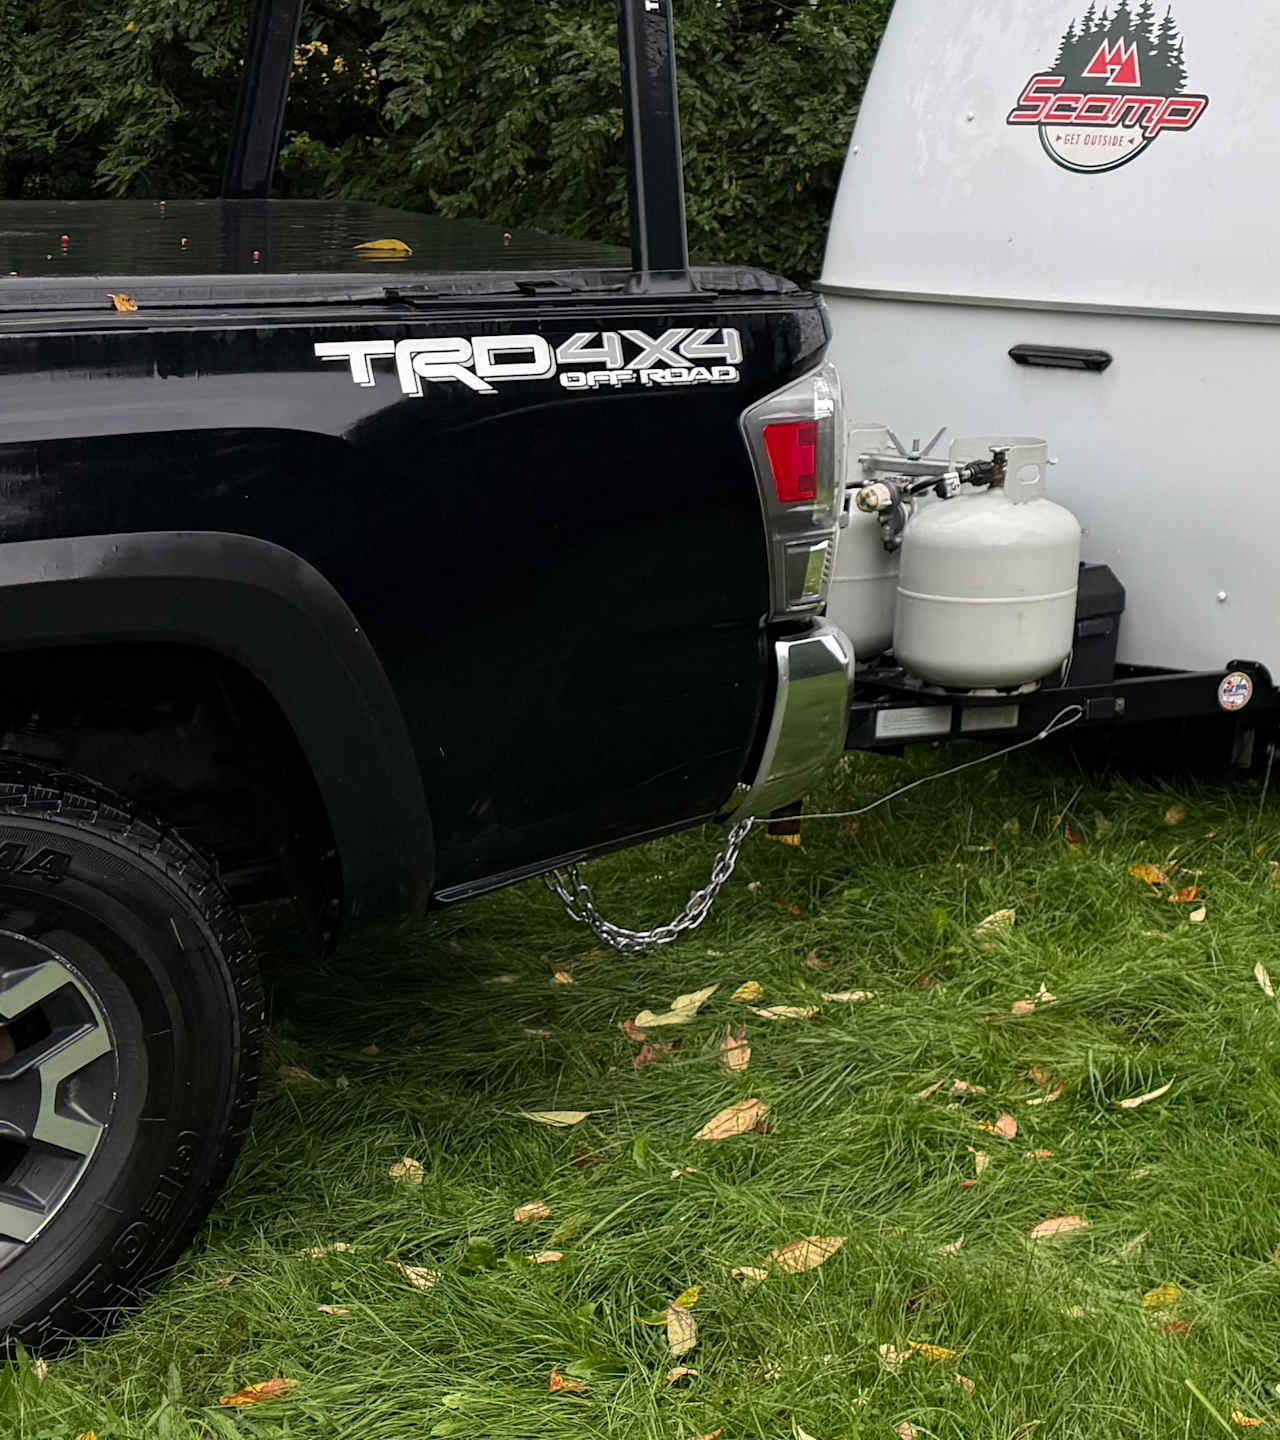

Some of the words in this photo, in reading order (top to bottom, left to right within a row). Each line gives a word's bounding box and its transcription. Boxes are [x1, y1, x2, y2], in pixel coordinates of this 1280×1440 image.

[1006, 72, 1209, 140] Scamp
[1063, 133, 1081, 146] GET
[1084, 134, 1124, 147] OUTSIDE
[313, 333, 555, 397] TRD
[556, 327, 743, 370] 4X4
[560, 371, 633, 391] OFF
[639, 364, 739, 386] ROAD
